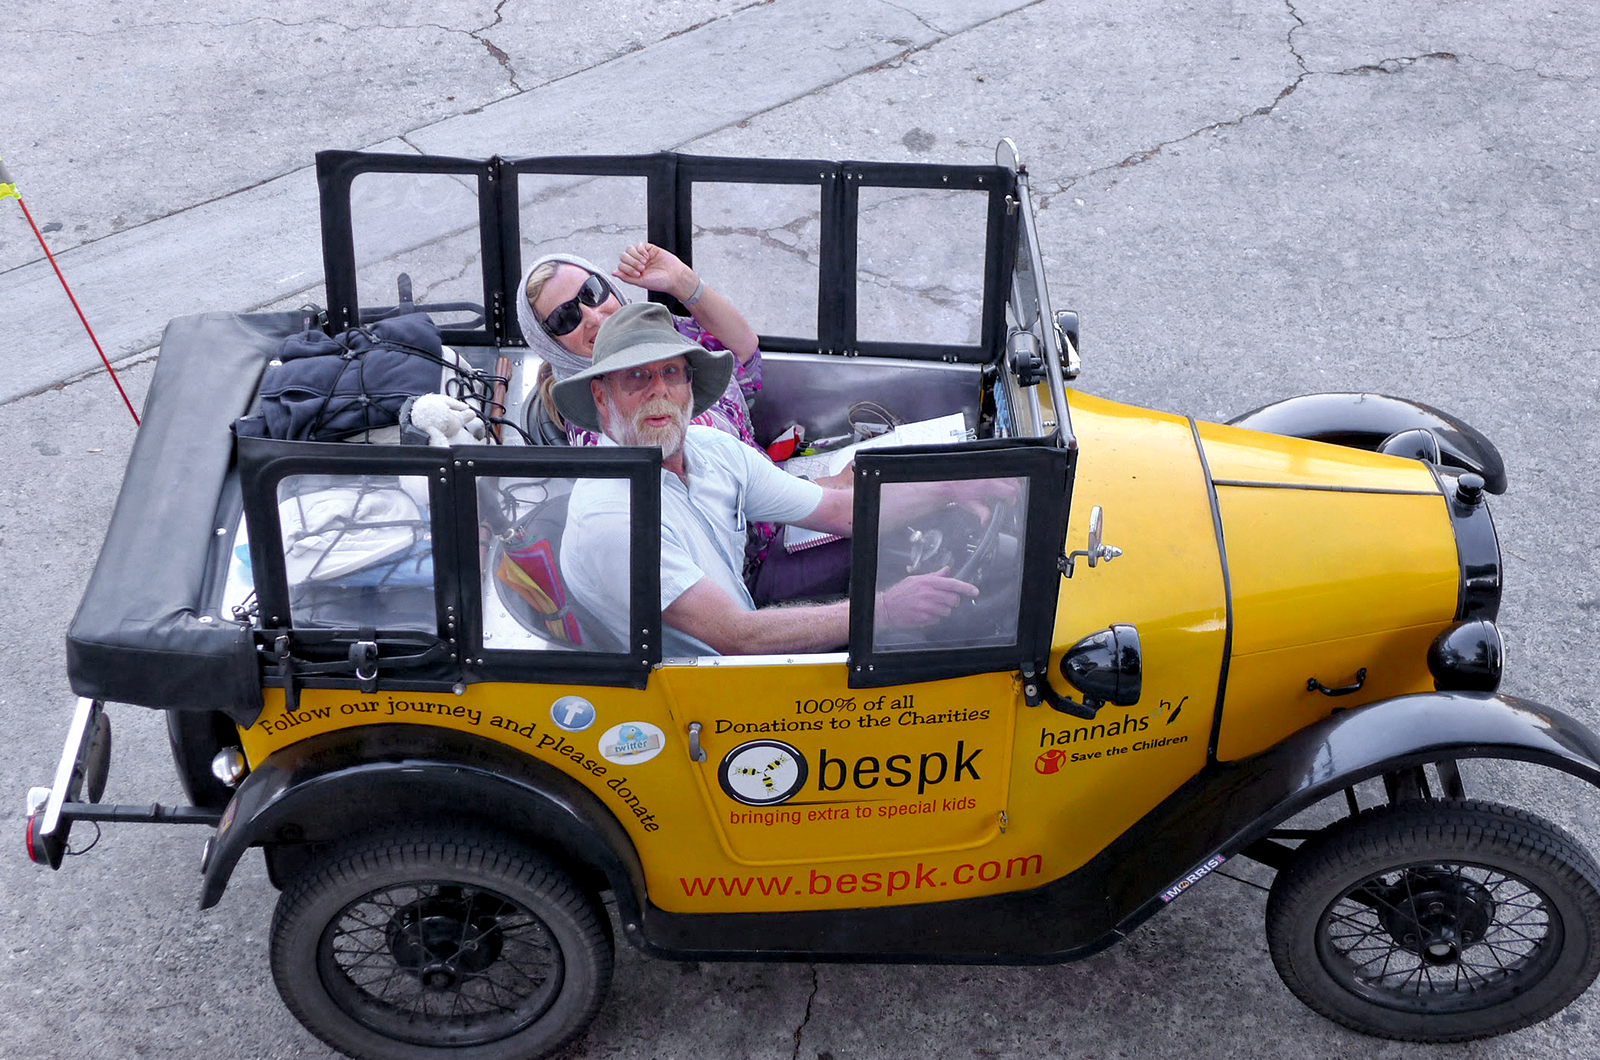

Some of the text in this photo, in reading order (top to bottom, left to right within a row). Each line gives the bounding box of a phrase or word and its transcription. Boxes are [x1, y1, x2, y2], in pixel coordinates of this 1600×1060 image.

[795, 695, 914, 714] 100% of all
[715, 707, 990, 734] Donations to the Charities
[1040, 714, 1149, 747] hannahs
[614, 740, 648, 753] twitter
[1070, 734, 1188, 762] Save the Children
[258, 696, 660, 833] Follow our journey and please donate
[817, 740, 983, 795] bespk
[730, 796, 977, 826] bringing extra to special kids
[680, 855, 1042, 897] www.bespk.com
[1166, 859, 1219, 898] MORRIS
